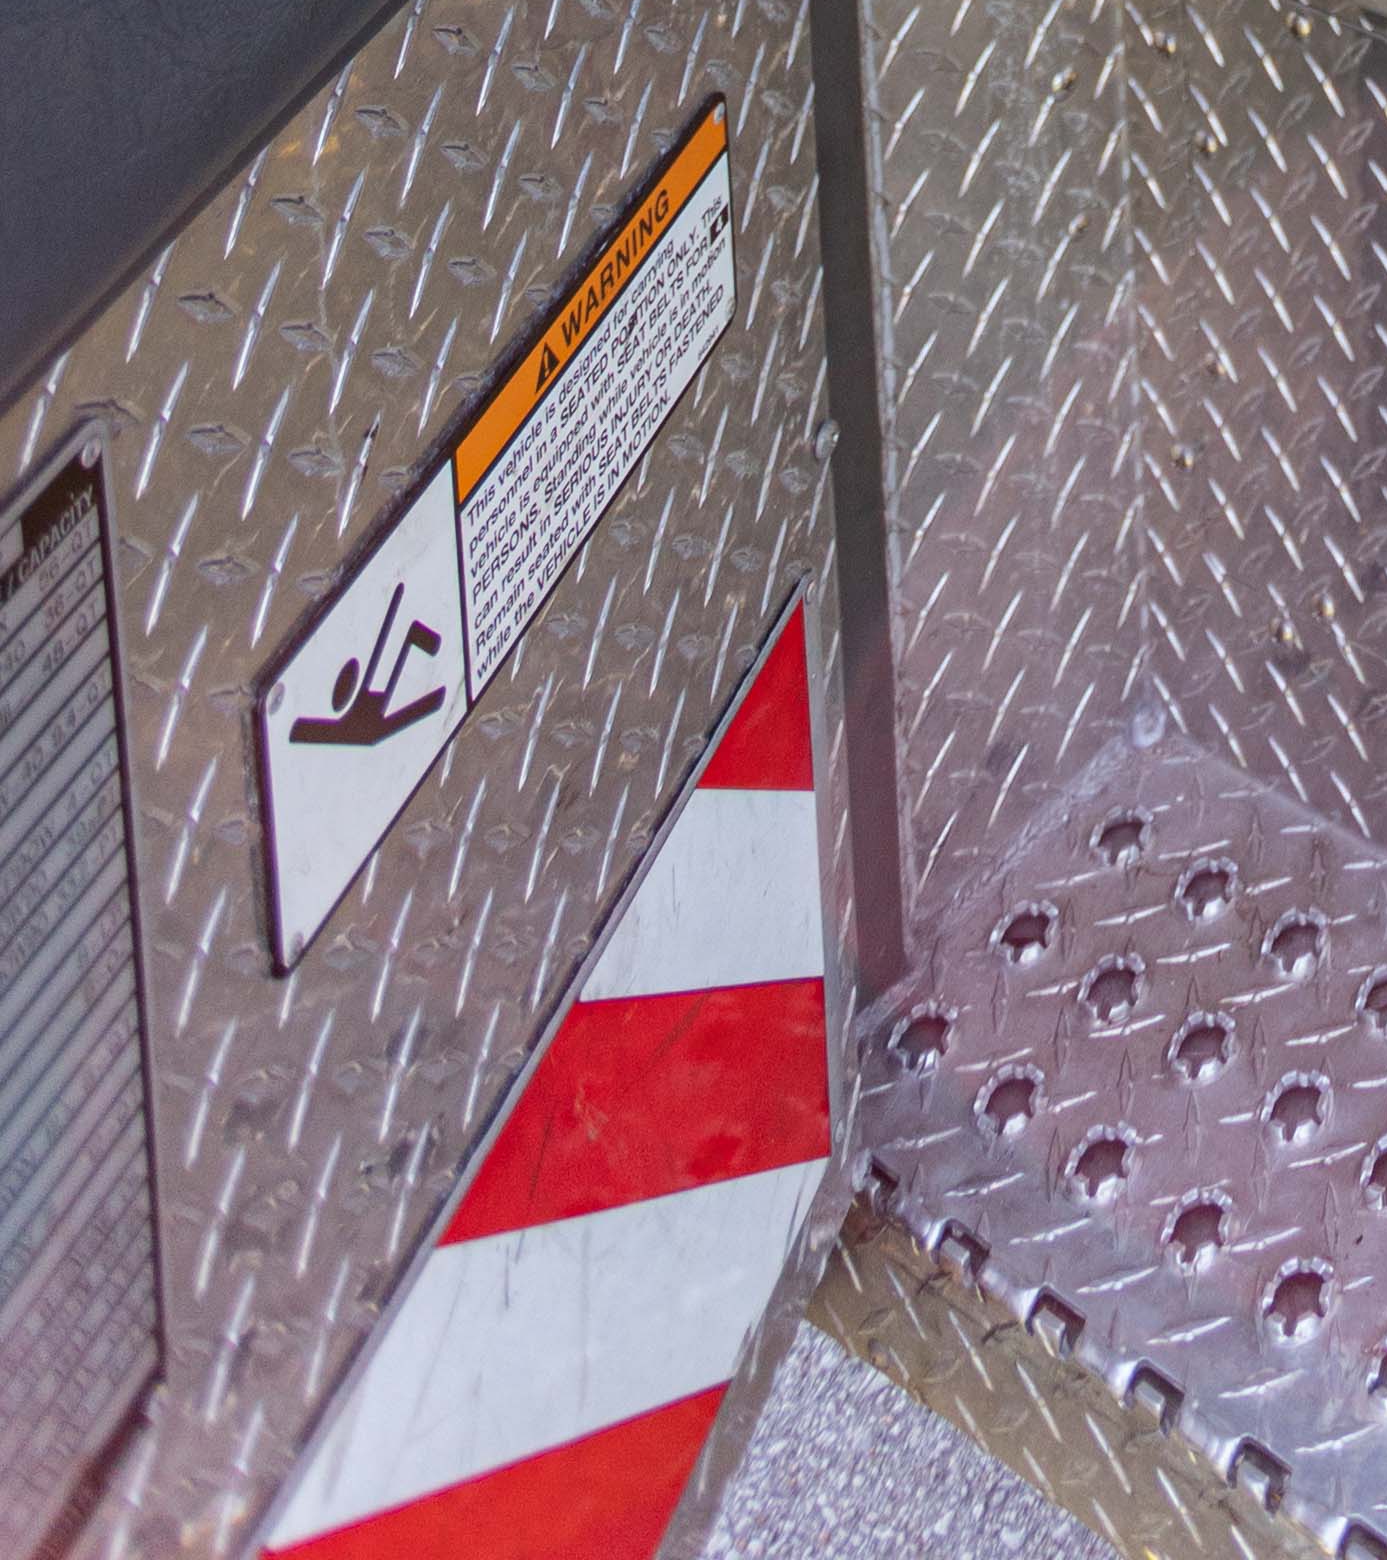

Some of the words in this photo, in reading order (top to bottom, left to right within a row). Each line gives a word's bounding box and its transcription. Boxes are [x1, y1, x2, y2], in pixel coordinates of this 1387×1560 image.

[467, 485, 495, 526] This
[498, 422, 542, 485] vehicle
[546, 403, 555, 424] is
[559, 323, 610, 404] designed
[613, 301, 628, 330] for
[632, 240, 673, 304] carrying
[470, 456, 532, 558] personnel
[536, 441, 547, 463] in
[550, 426, 557, 444] a
[560, 353, 608, 428] SEATED
[612, 273, 664, 358] POSITION
[667, 228, 699, 277] ONLY.
[702, 196, 721, 228] This
[471, 511, 516, 578] vehicle
[520, 491, 530, 512] is
[533, 405, 588, 492] equipped
[591, 372, 614, 410] with
[618, 322, 646, 374] SEAT
[649, 270, 683, 328] BELTS
[686, 236, 708, 276] FOR
[473, 502, 541, 605] PERSONS.
[545, 424, 596, 503] Standing
[599, 380, 627, 424] while
[630, 323, 666, 379] vehicle
[670, 306, 678, 324] is
[681, 290, 689, 308] in
[692, 238, 725, 292] motion
[561, 188, 670, 346] WARNING
[475, 590, 498, 629] can
[502, 532, 537, 592] result
[540, 514, 550, 536] in
[554, 428, 608, 516] SERIOUS
[611, 363, 652, 434] INJURY
[656, 336, 671, 368] OR
[674, 280, 712, 342] DEATH.
[476, 578, 524, 656] Remain
[528, 510, 568, 580] seated
[572, 476, 596, 515] with
[599, 422, 627, 476] SEAT
[632, 368, 666, 429] BELTS
[669, 284, 723, 374] FASTENED
[478, 626, 510, 678] while
[514, 592, 534, 626] the
[537, 504, 590, 590] VEHICLE
[594, 484, 604, 510] IS
[608, 462, 619, 489] IN
[623, 390, 670, 468] MOTION.
